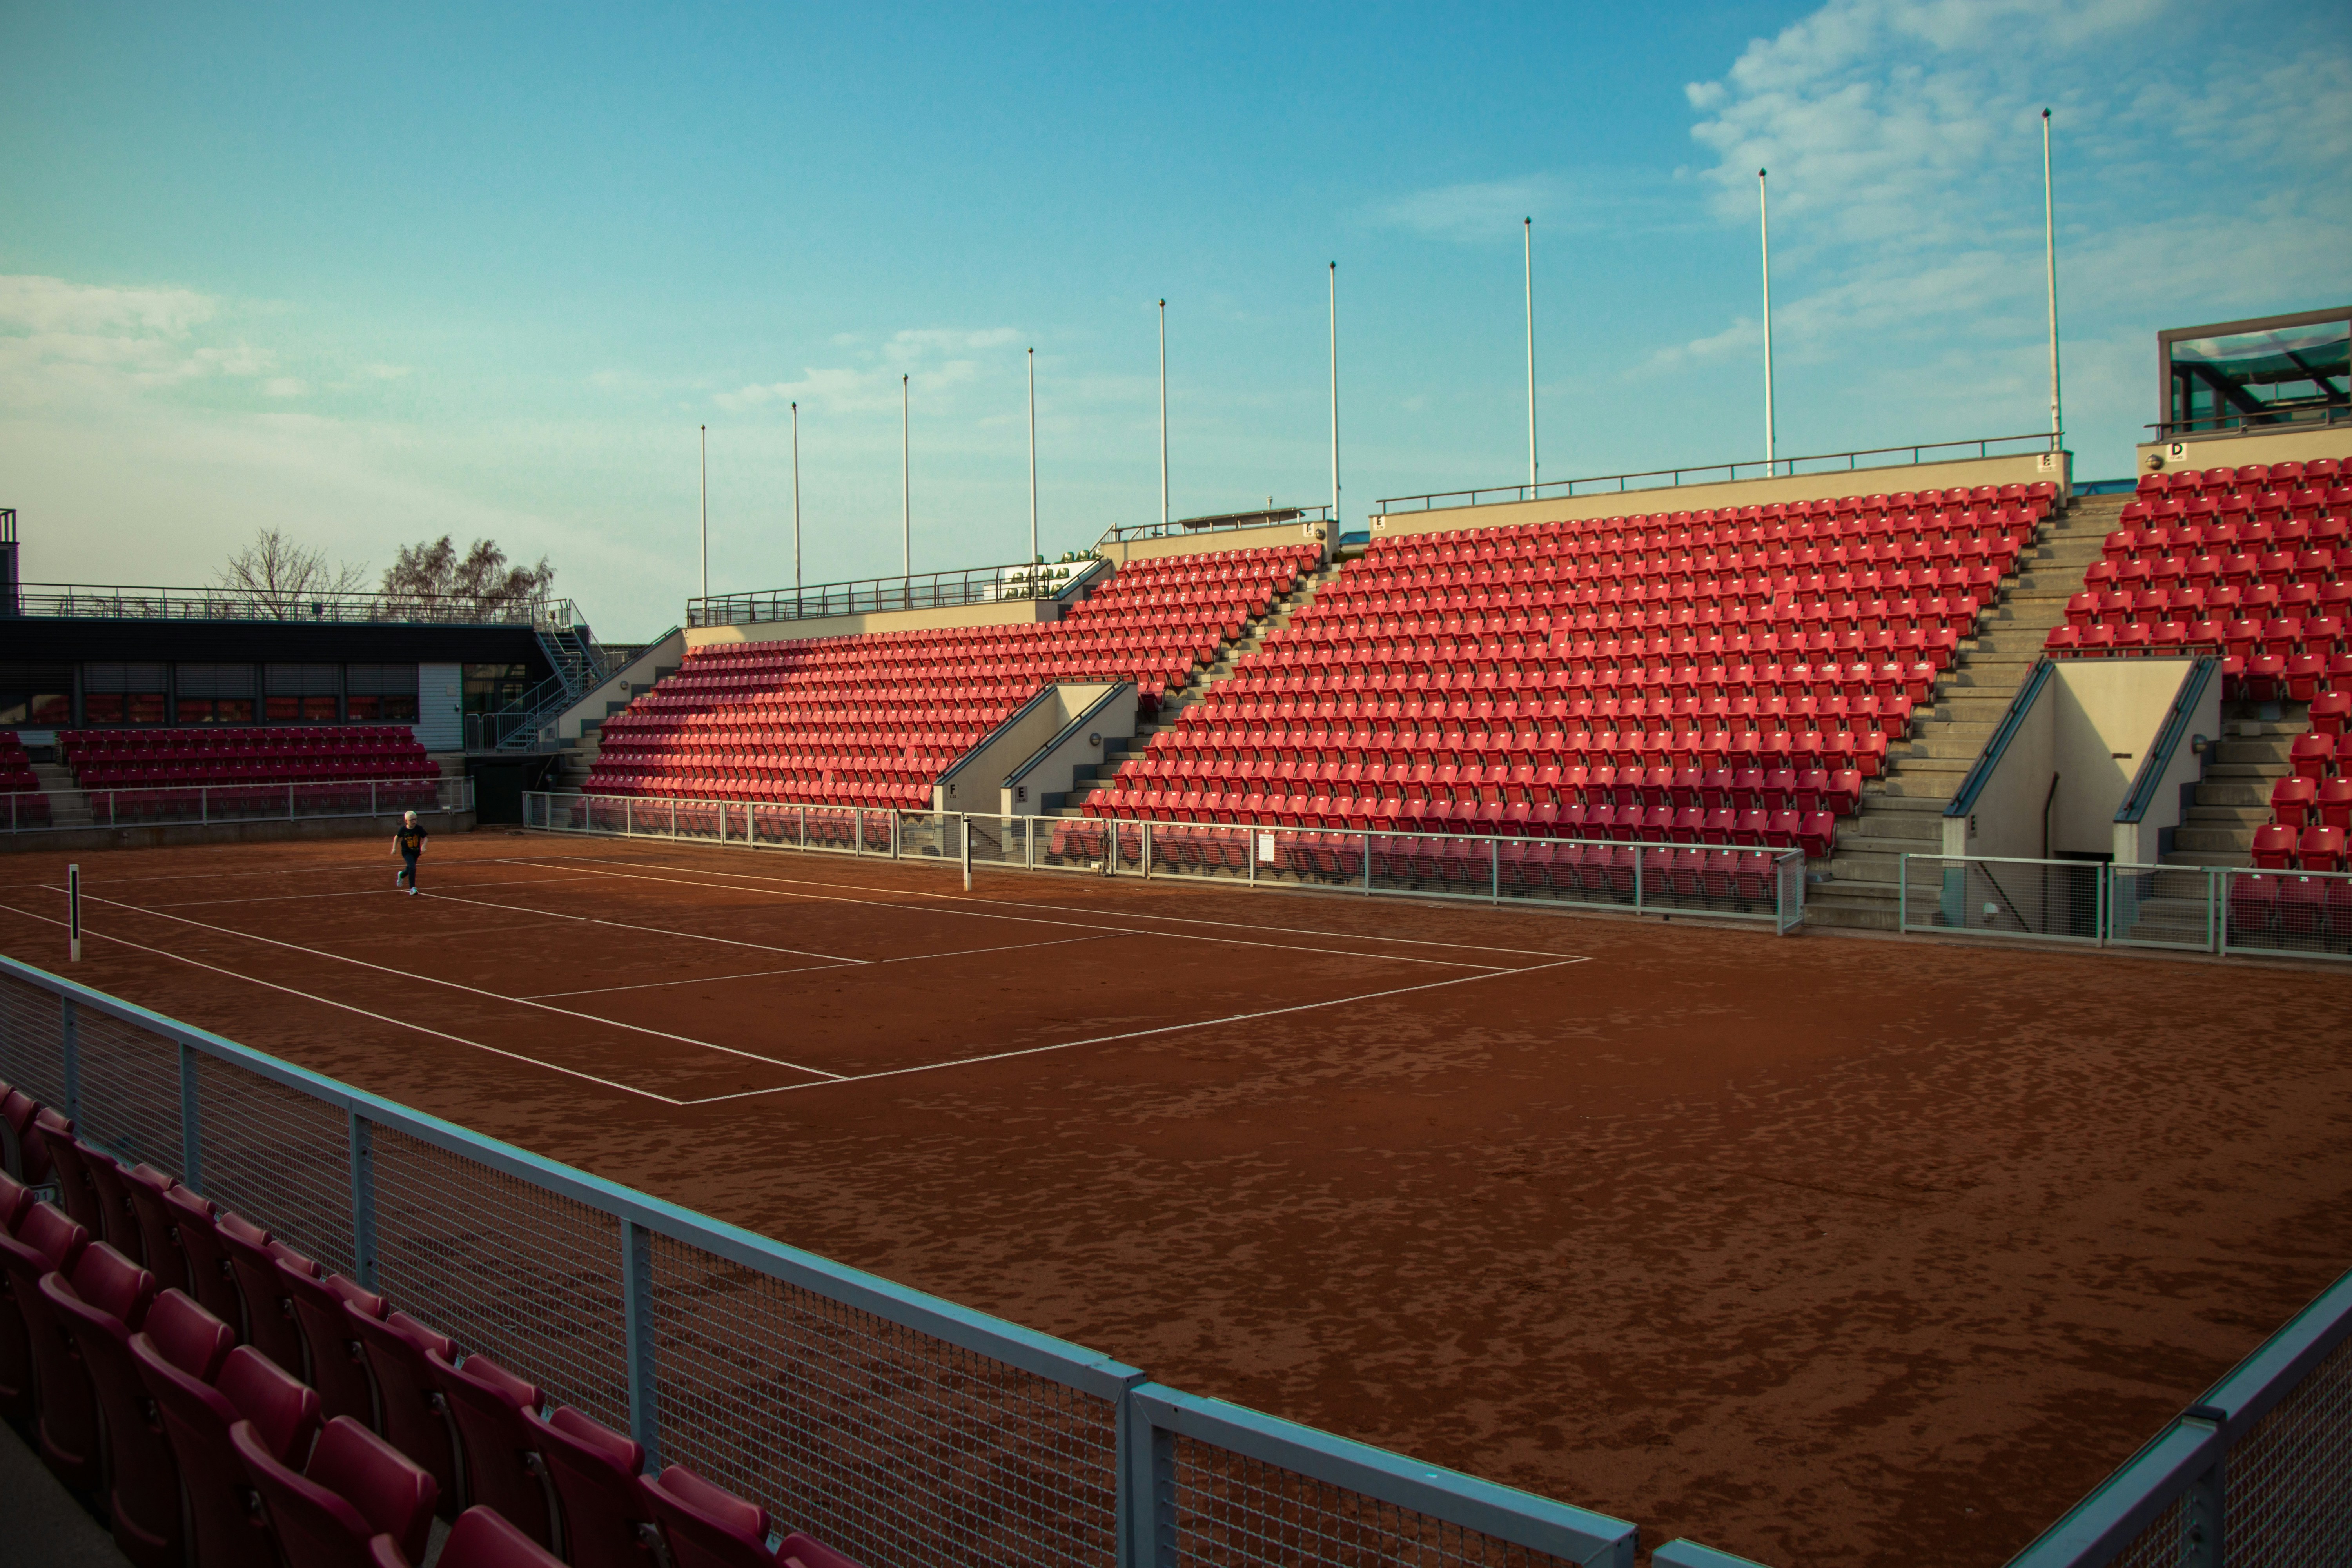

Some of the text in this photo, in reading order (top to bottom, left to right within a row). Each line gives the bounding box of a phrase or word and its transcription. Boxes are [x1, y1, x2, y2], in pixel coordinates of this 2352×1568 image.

[2172, 443, 2183, 455] D
[1377, 516, 1381, 526] E
[950, 784, 955, 794] F
[1018, 787, 1024, 797] E
